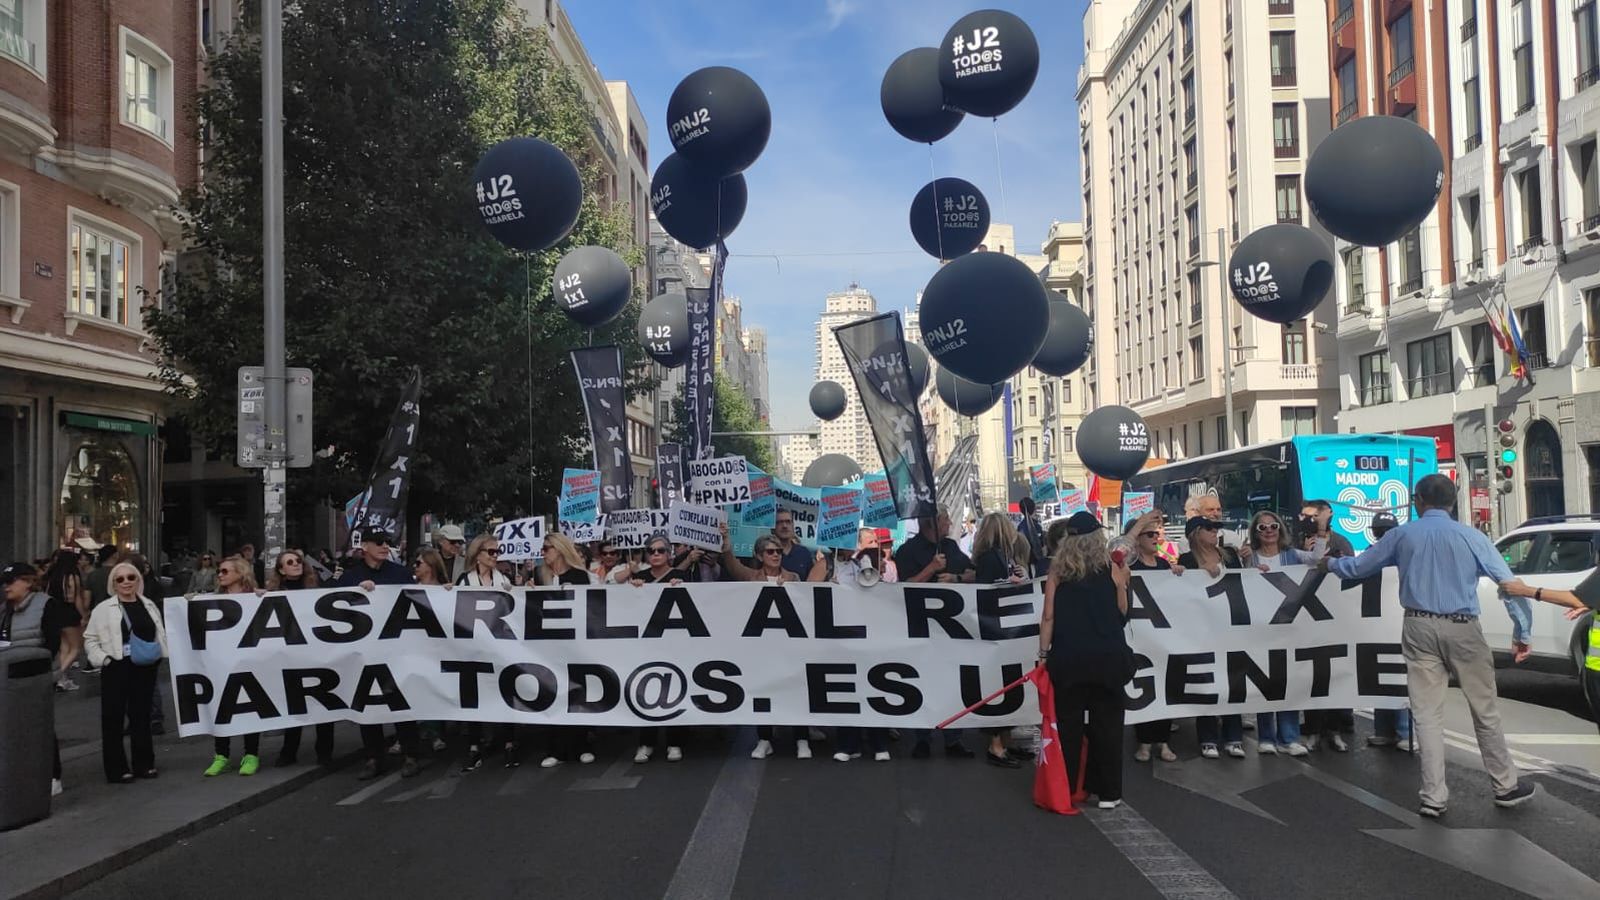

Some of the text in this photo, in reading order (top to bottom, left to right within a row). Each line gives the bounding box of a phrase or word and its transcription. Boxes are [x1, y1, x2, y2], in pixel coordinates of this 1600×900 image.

[953, 26, 1000, 56] #J2
[952, 49, 1003, 70] TOD@S
[955, 62, 1002, 79] PASARELA
[476, 174, 517, 203] #J2
[479, 197, 523, 217] TOD@S
[944, 194, 978, 212] #J2
[944, 212, 980, 222] TOD@S
[559, 273, 582, 291] #J2
[1234, 261, 1273, 286] #J2
[564, 287, 586, 304] 1x1
[646, 325, 672, 339] #J2
[650, 341, 672, 352] 1x1
[1119, 422, 1147, 436] #J2
[1360, 457, 1384, 470] 001
[1336, 472, 1378, 486] MADRID
[695, 485, 749, 505] #PNJ2
[496, 520, 540, 541] 1X1
[710, 516, 719, 529] LA
[500, 541, 530, 555] OD@S
[187, 569, 1382, 650] PASARELA AL REA 1X1
[175, 642, 1410, 725] PARA TOD@S. ES UGENTE
